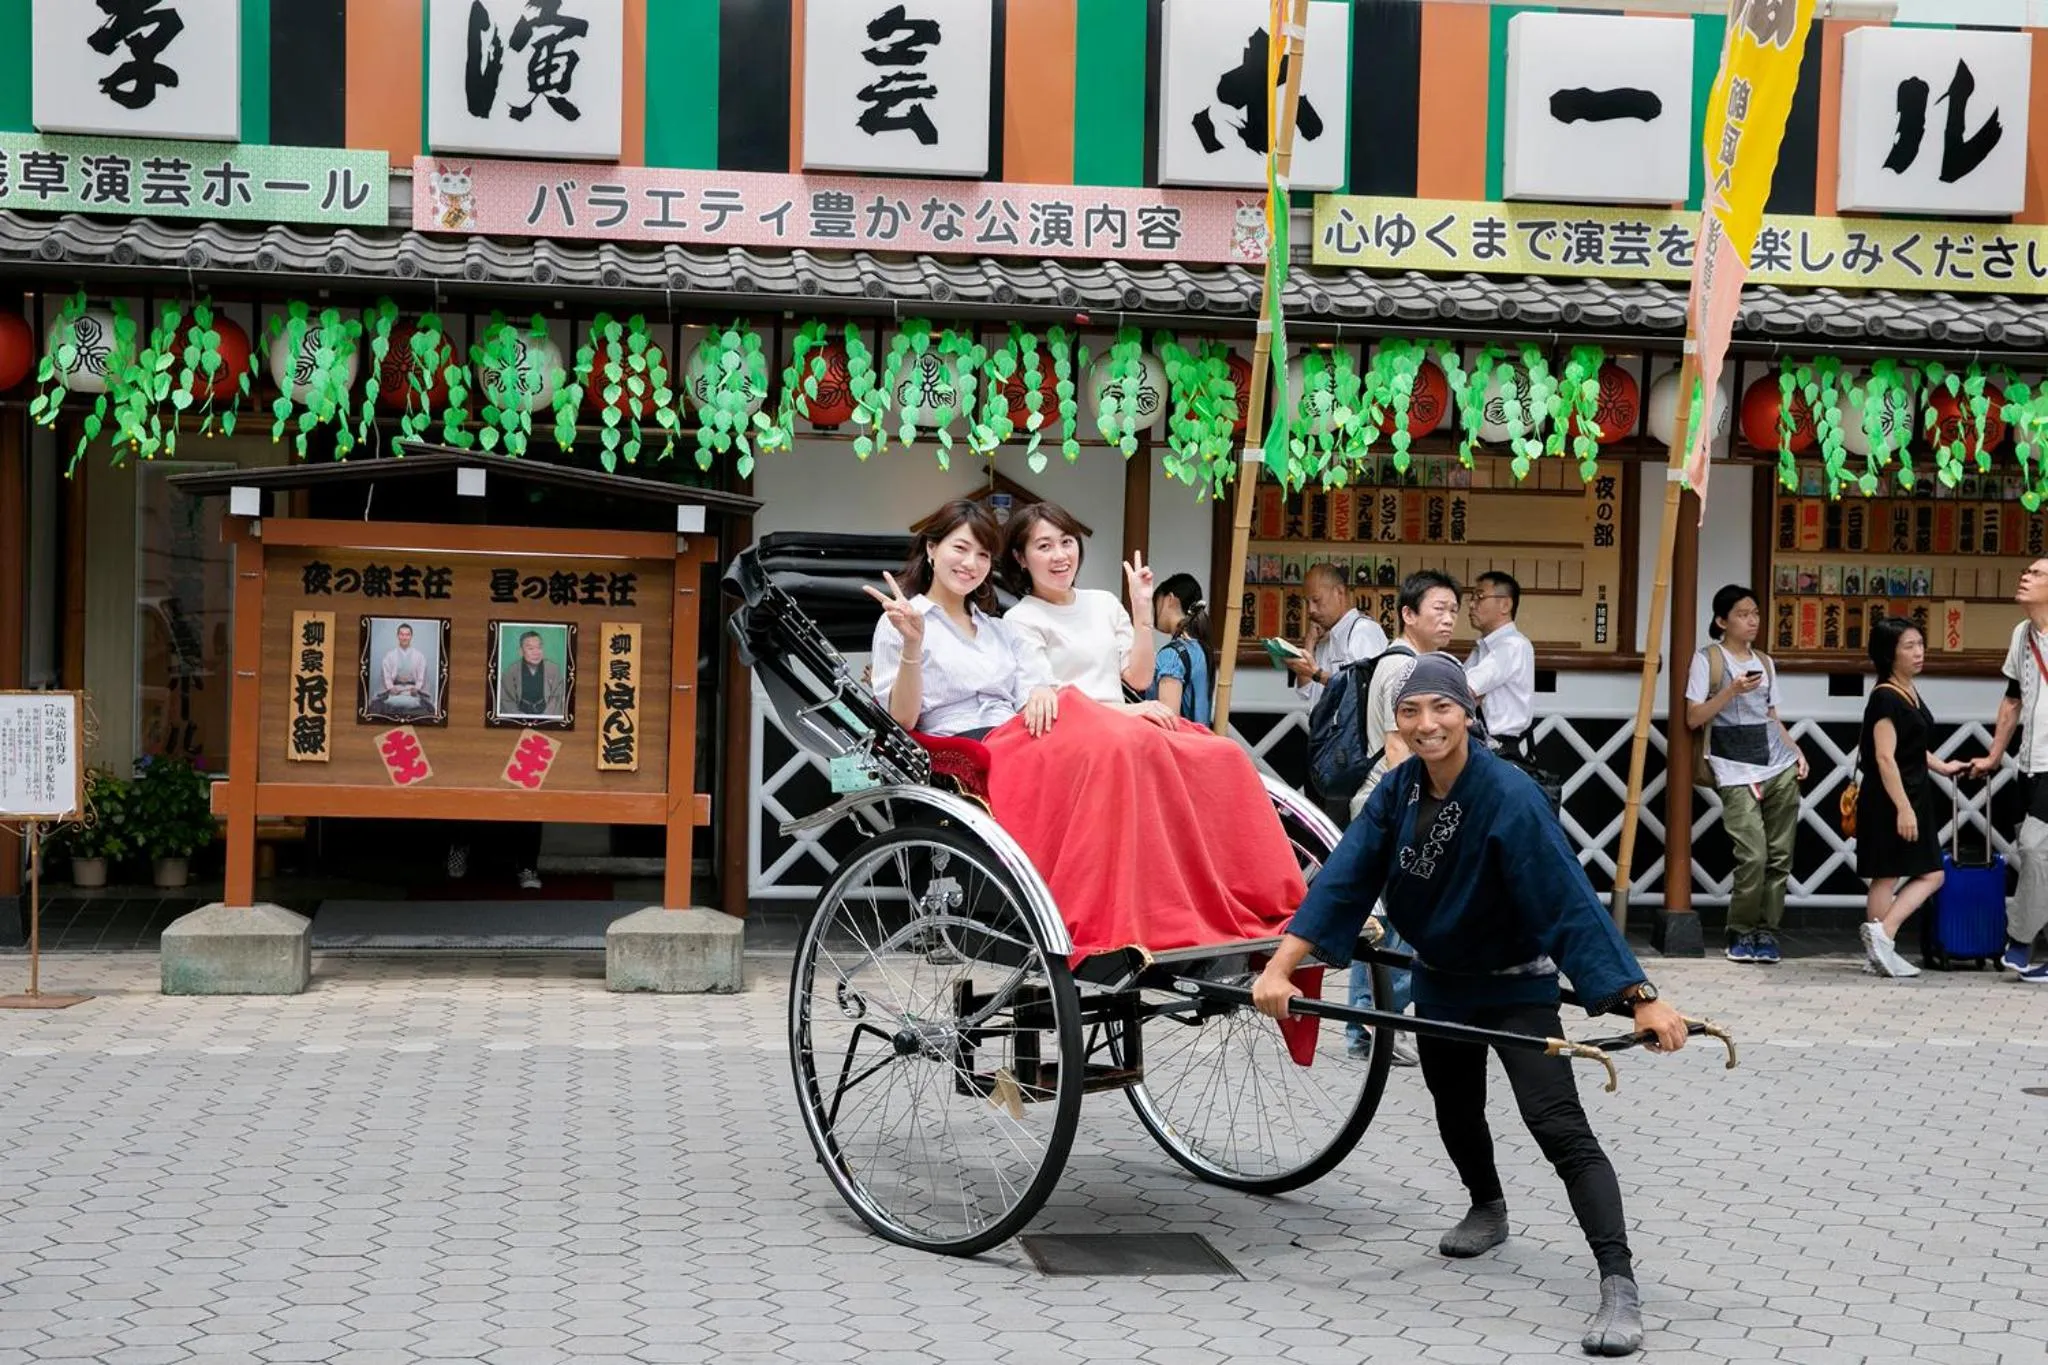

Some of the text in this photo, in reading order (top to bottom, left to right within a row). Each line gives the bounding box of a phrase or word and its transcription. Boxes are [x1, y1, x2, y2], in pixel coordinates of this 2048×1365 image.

[855, 5, 941, 145] 芸
[1883, 57, 2003, 184] ル
[0, 149, 370, 210] 草演芸ホール
[526, 184, 1182, 250] バラエティ豊かな公演内容
[1324, 209, 2048, 278] 心ゆくまで演芸を楽しみください
[1593, 476, 1616, 549] 夜の部
[302, 561, 452, 599] 夜の部主任
[489, 568, 638, 606] 昼の部主任
